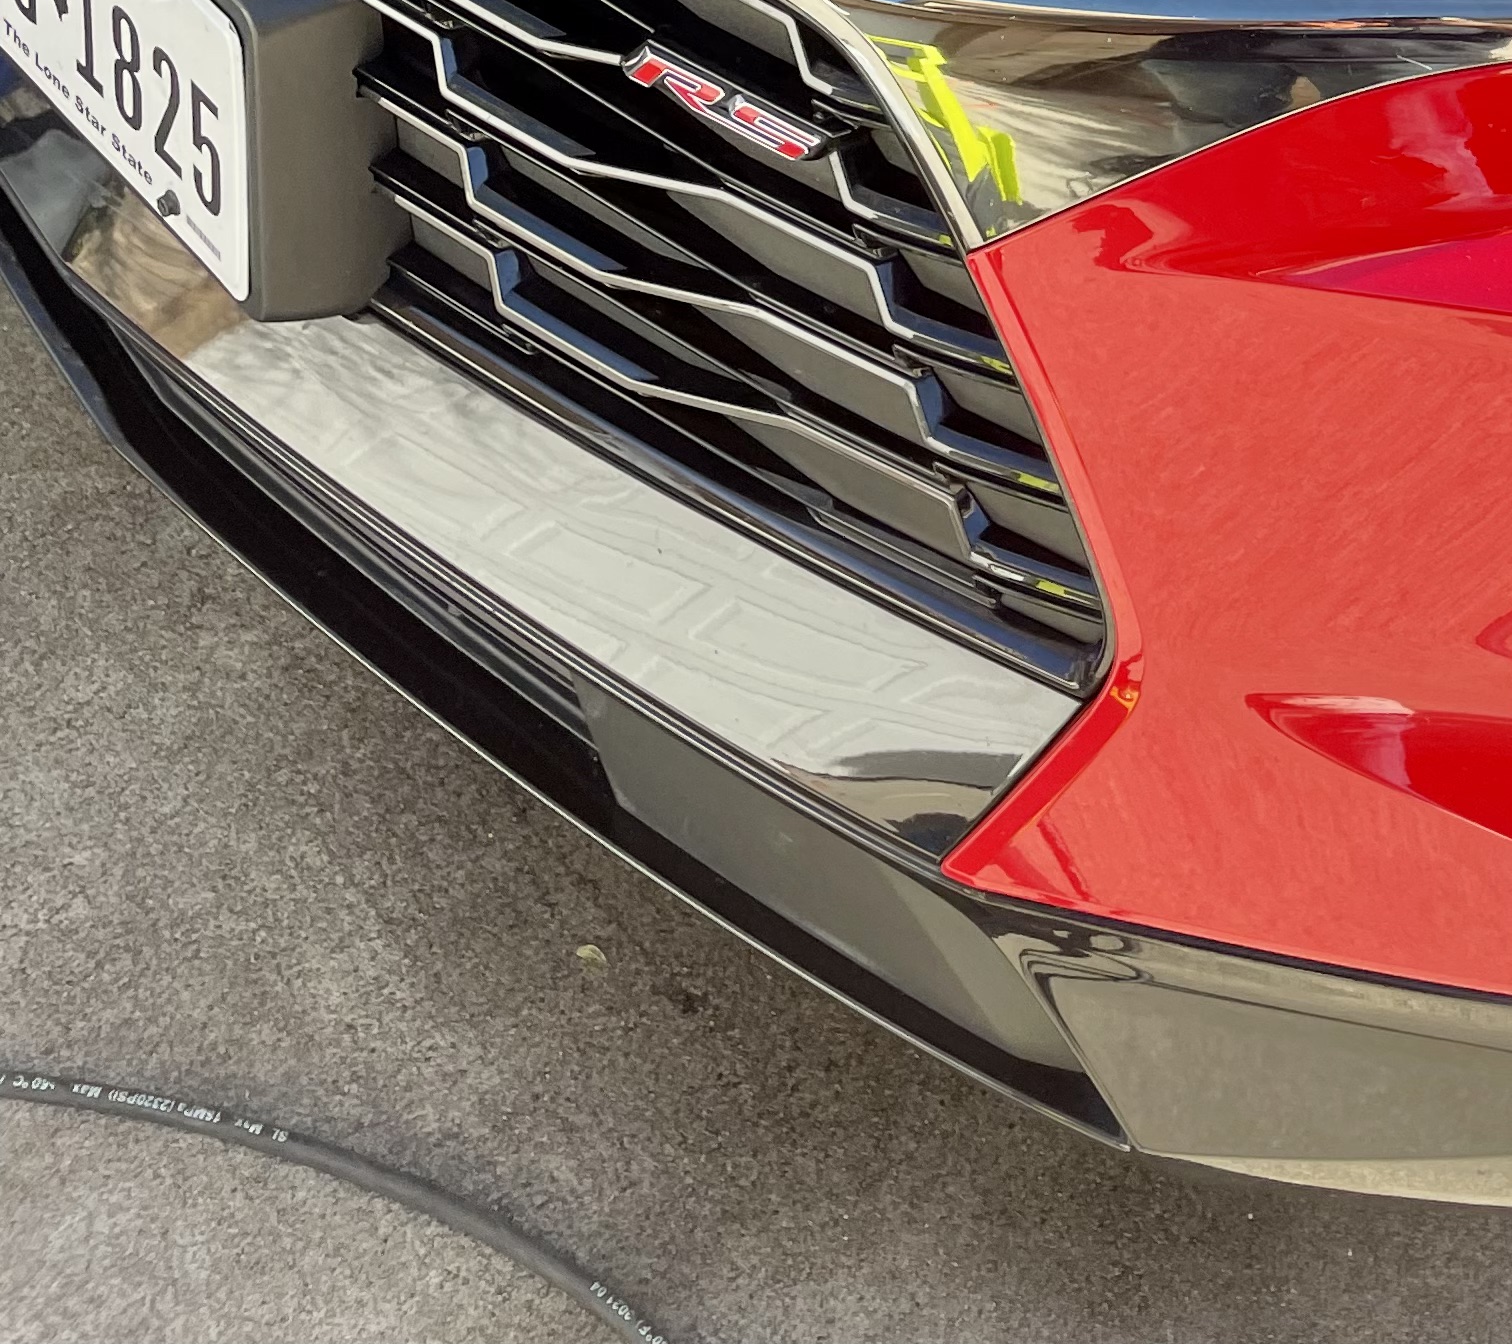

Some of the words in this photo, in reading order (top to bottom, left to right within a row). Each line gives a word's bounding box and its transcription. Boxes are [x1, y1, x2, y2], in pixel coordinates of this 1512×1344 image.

[3, 17, 30, 58] The
[35, 51, 70, 99] Lone
[74, 95, 107, 137] Star
[111, 133, 153, 186] State
[623, 45, 822, 160] RS
